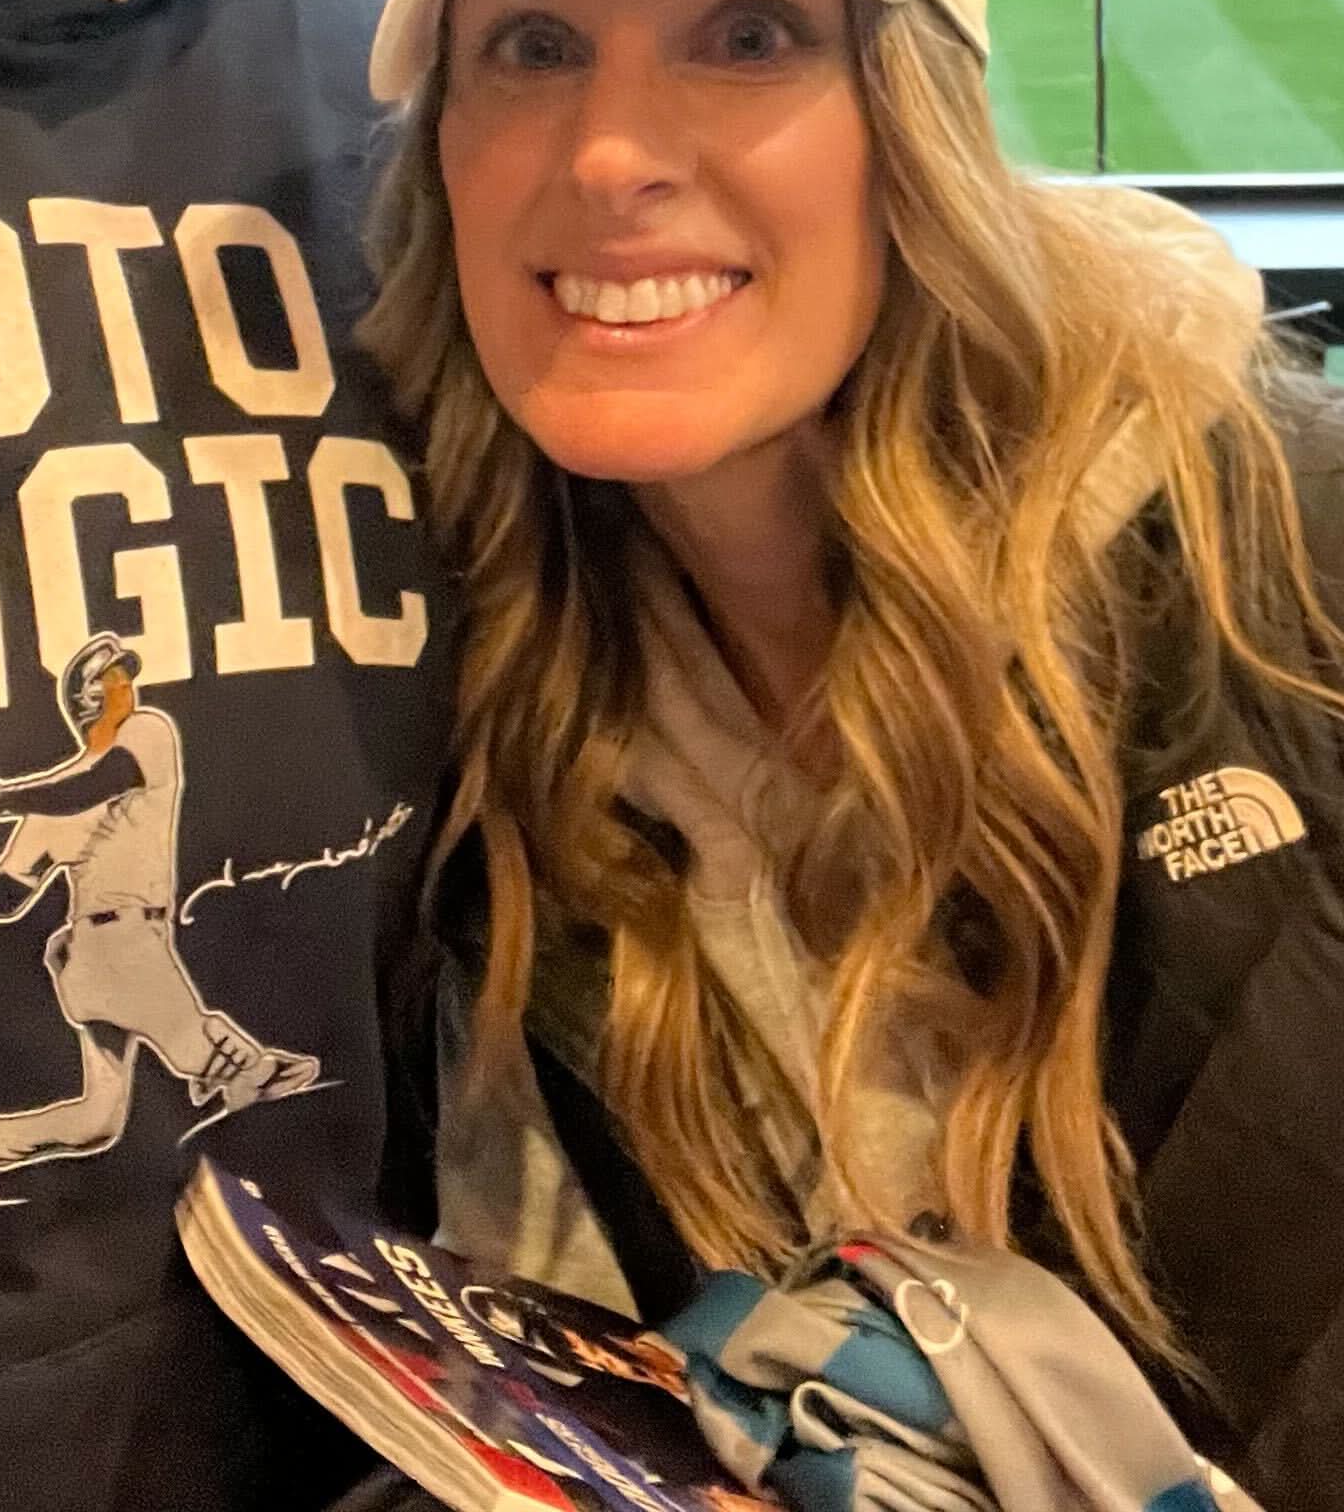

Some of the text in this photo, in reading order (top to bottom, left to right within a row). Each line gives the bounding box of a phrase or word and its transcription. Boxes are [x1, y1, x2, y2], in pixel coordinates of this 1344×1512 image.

[1158, 771, 1224, 815] THE
[1136, 800, 1242, 860] NORTH
[1163, 832, 1247, 882] FACE
